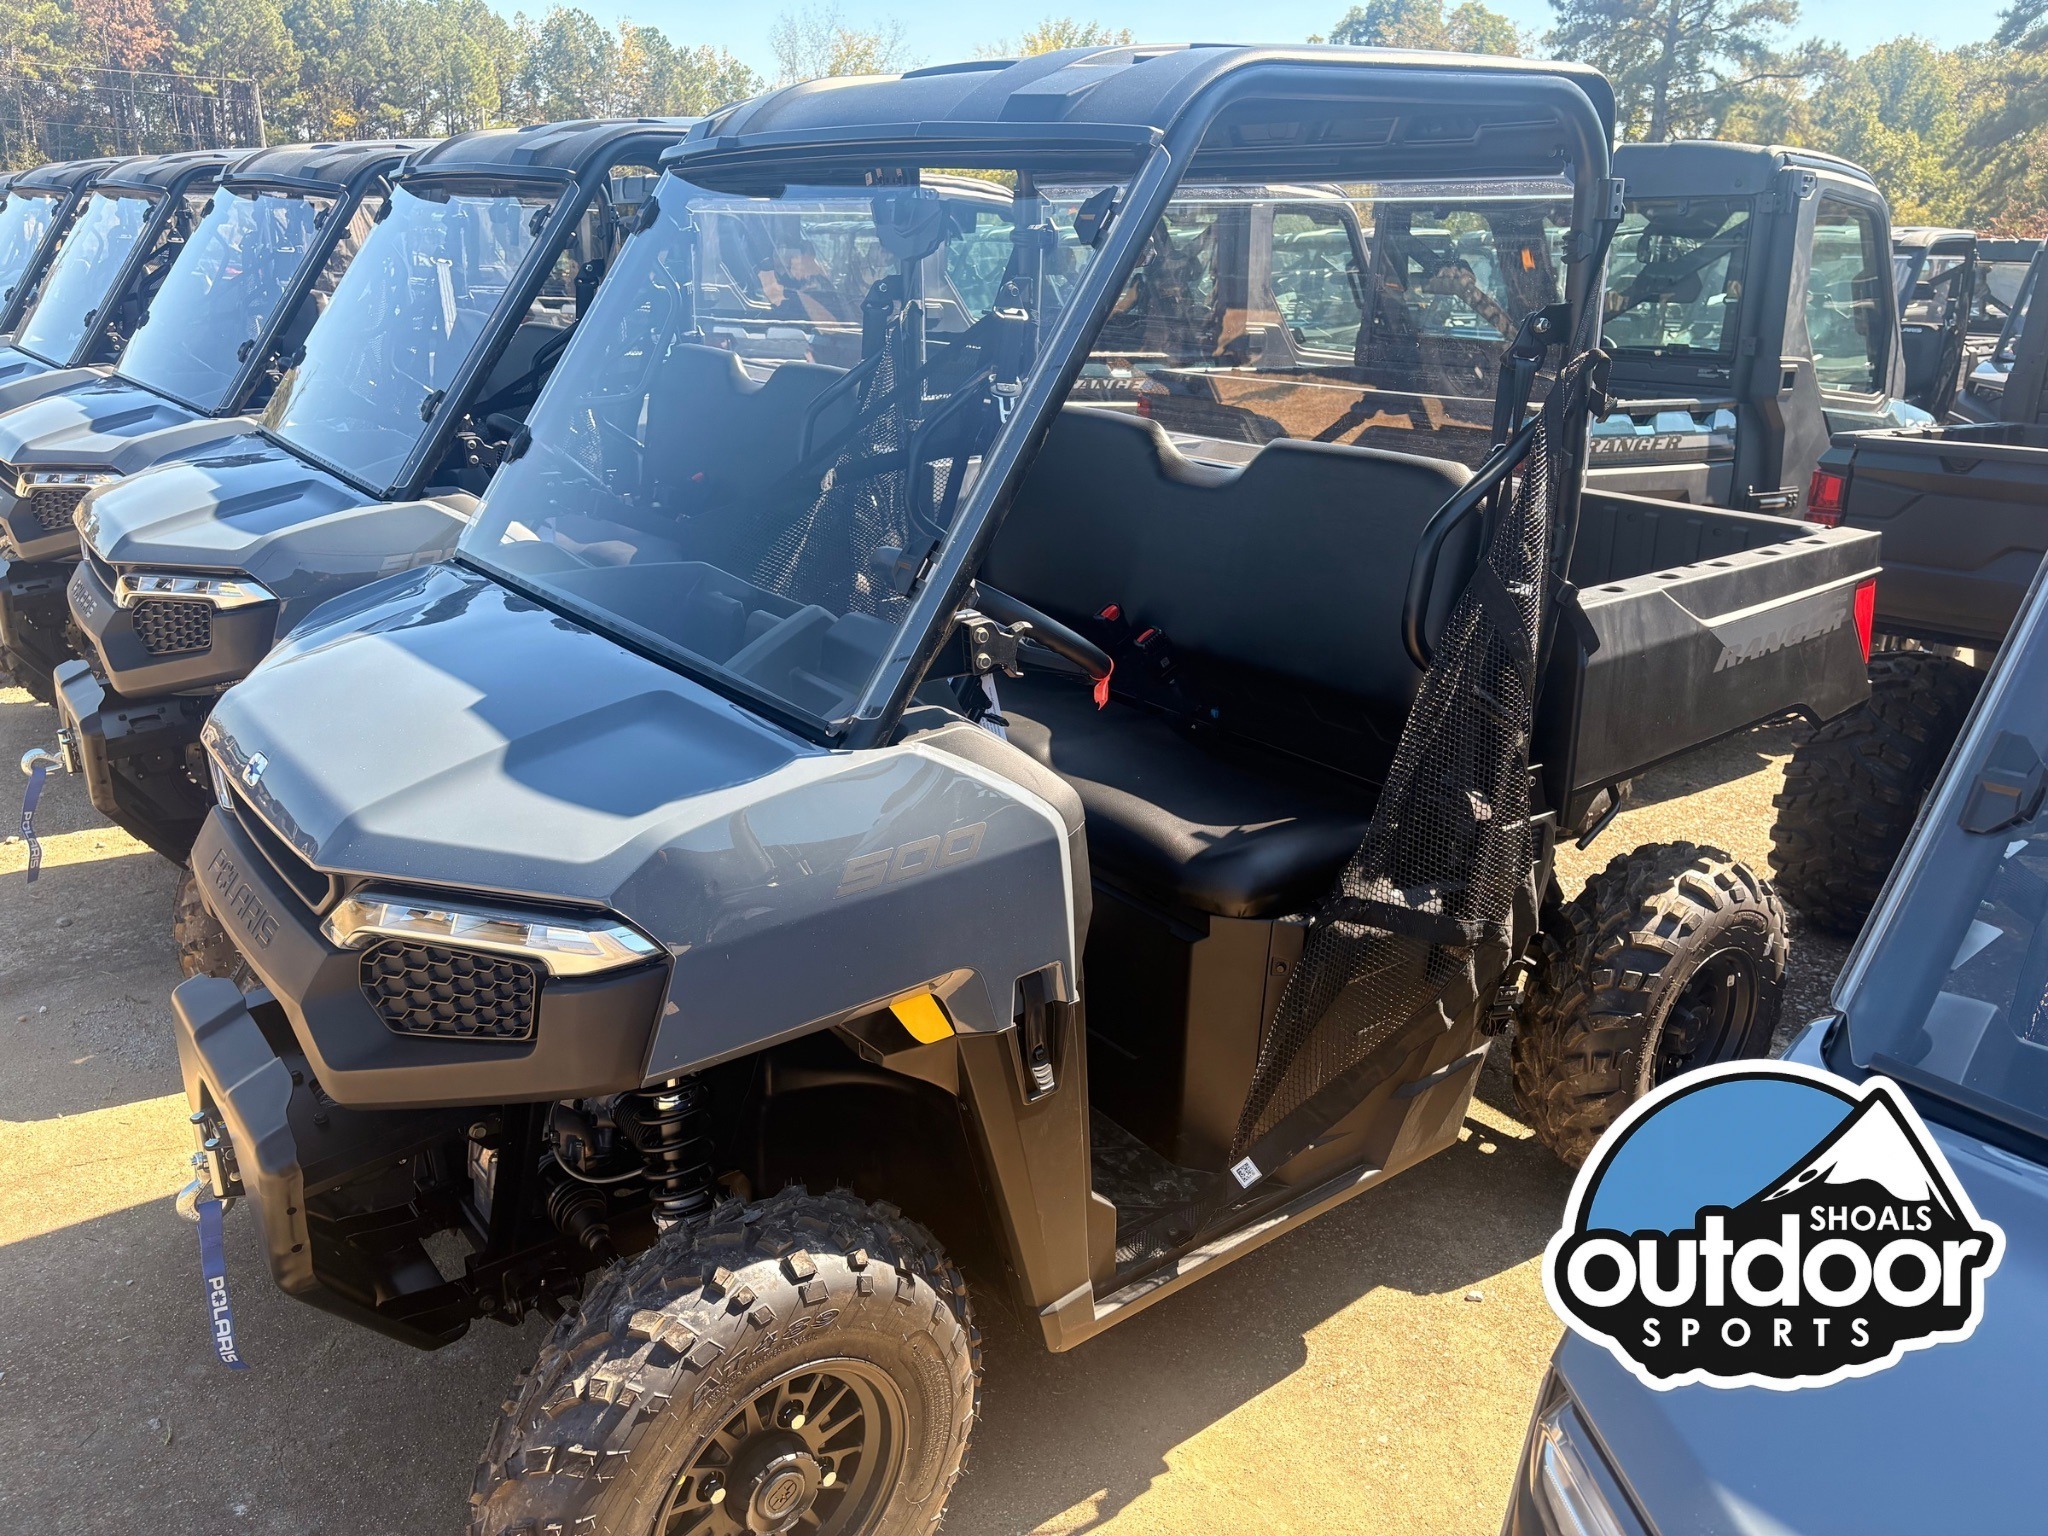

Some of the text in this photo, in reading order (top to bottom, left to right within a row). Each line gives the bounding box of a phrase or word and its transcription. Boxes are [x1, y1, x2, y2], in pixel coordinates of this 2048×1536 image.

[1589, 434, 1683, 452] RANGER
[22, 811, 40, 869] POLARIS
[833, 821, 987, 900] 500
[207, 848, 281, 951] POLARIS
[208, 1275, 239, 1363] POLARIS
